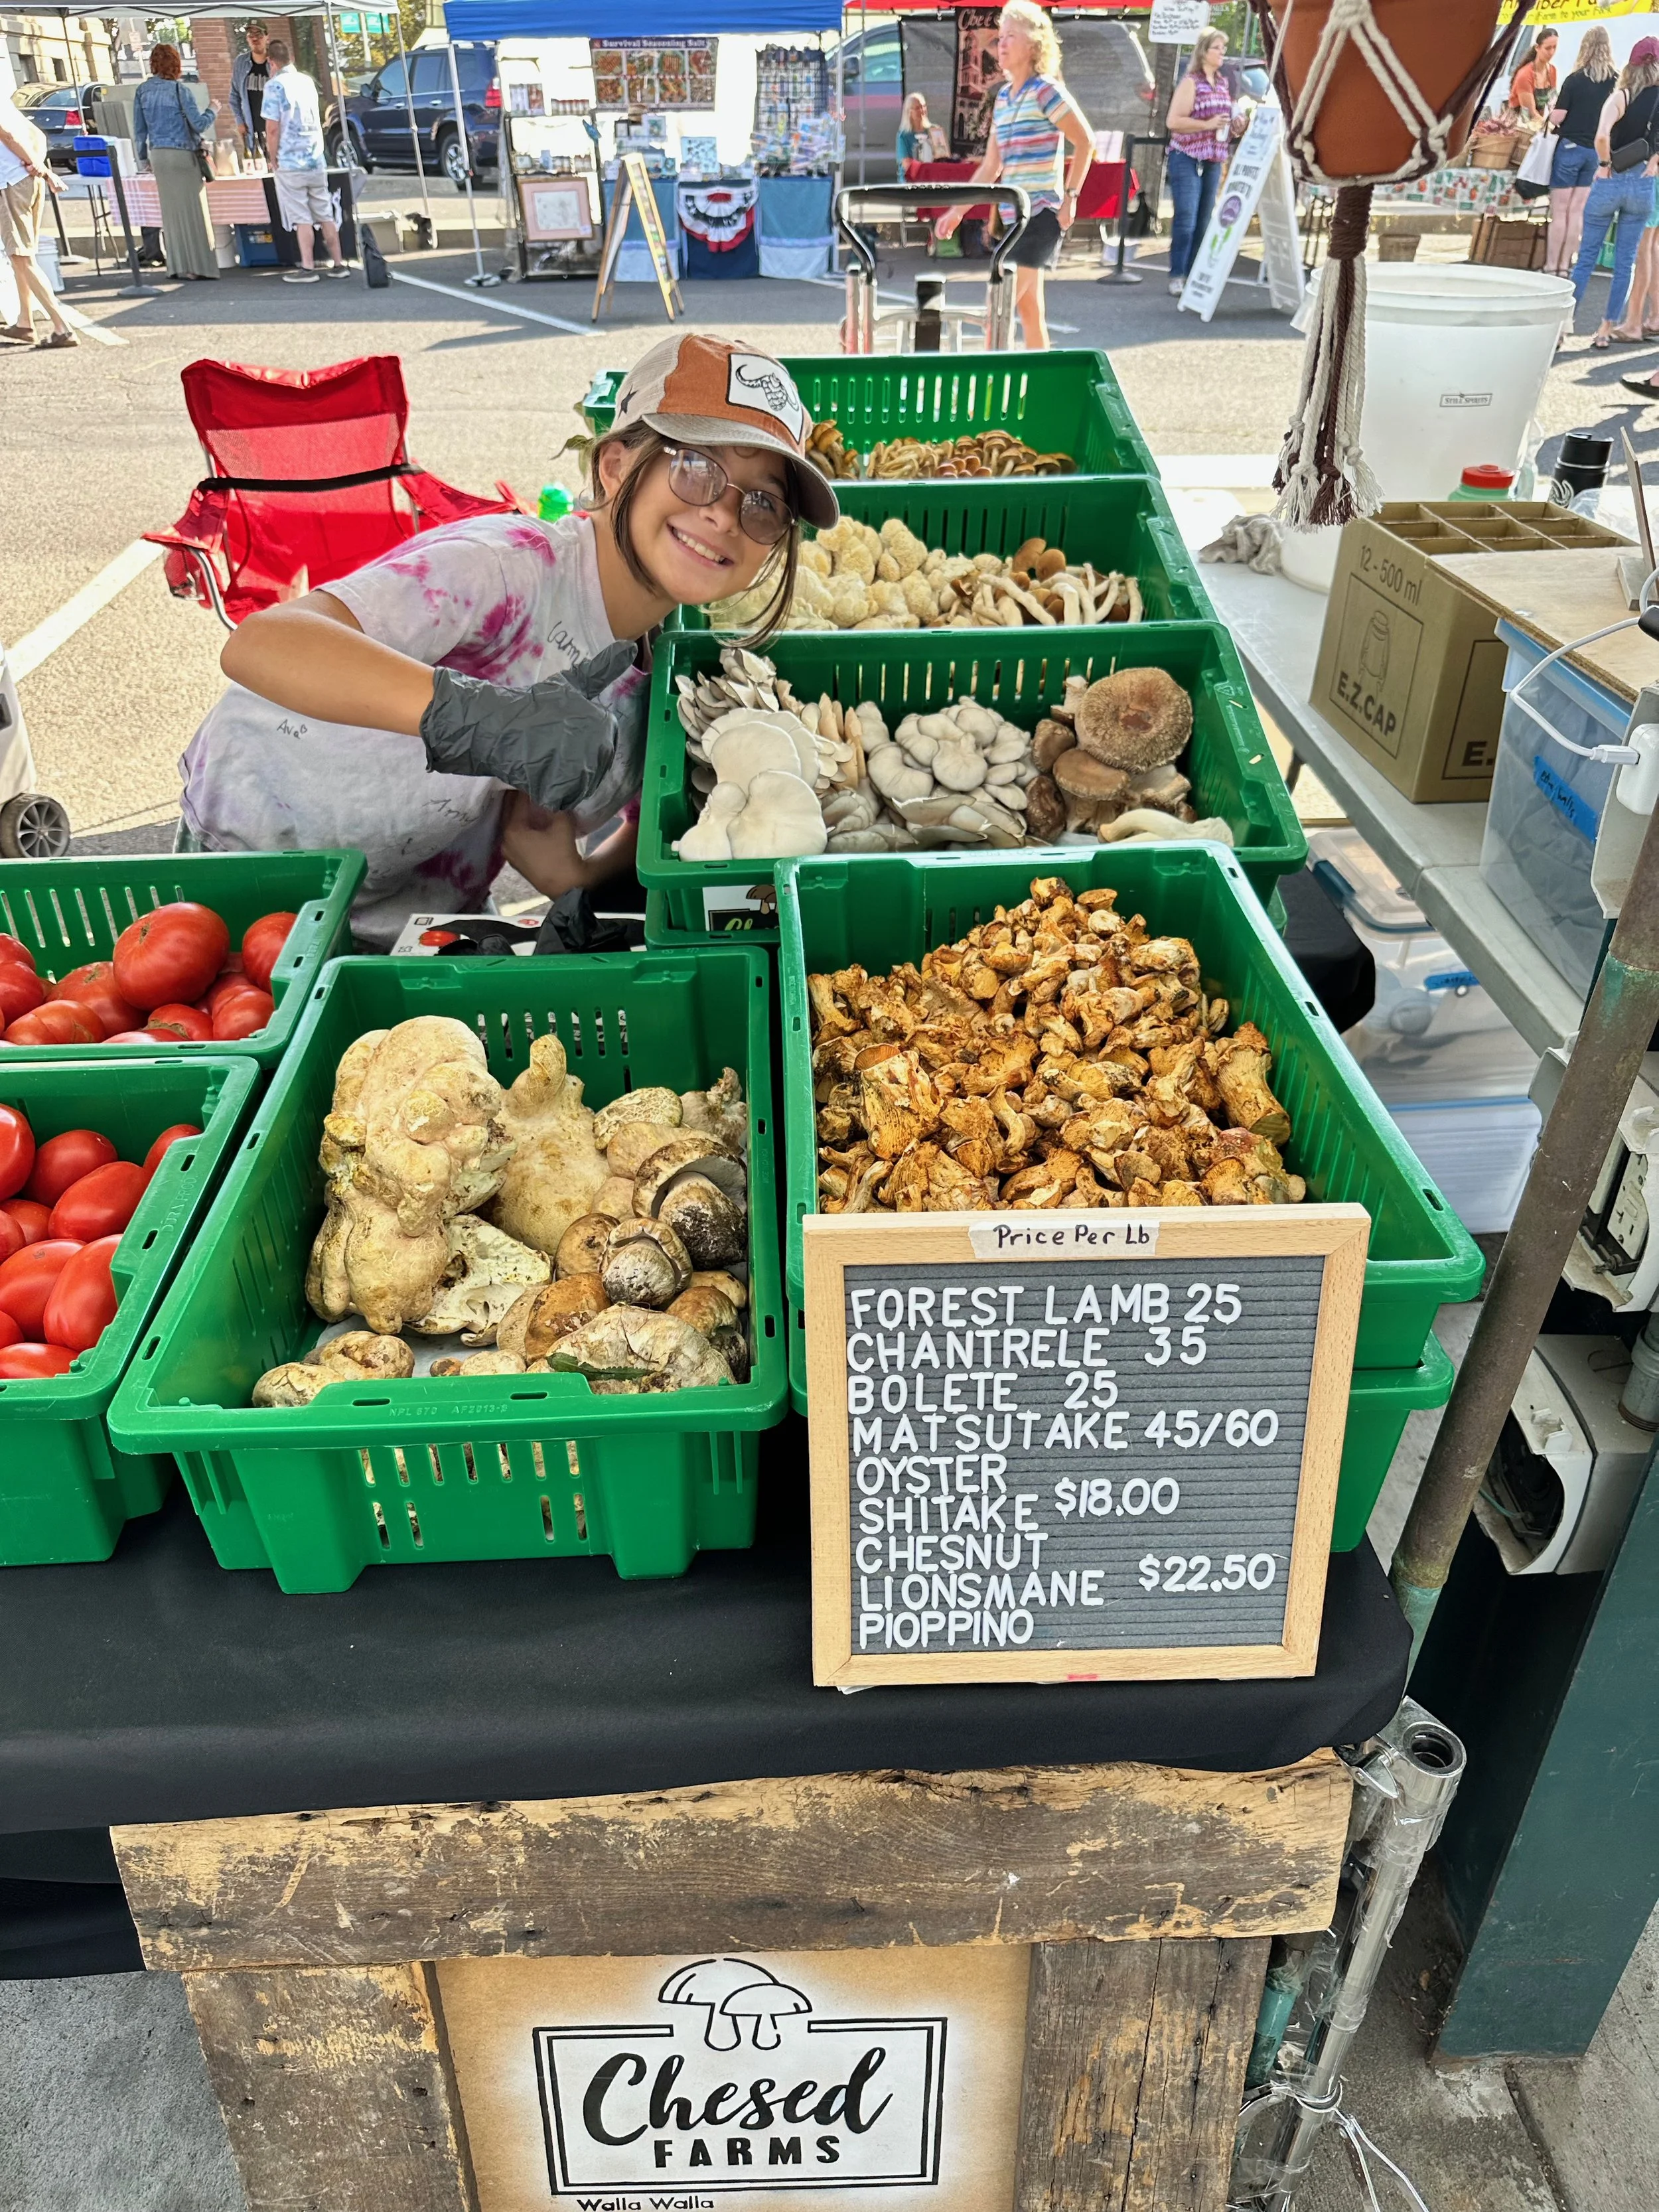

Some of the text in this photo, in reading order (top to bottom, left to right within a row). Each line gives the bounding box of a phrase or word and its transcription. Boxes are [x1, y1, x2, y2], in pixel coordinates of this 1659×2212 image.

[1360, 544, 1371, 573] 12
[1380, 558, 1404, 595] 500
[1404, 579, 1423, 607] ml
[1336, 670, 1398, 737] E.Z.CAP
[276, 718, 301, 740] Ava
[993, 1221, 1150, 1248] Price Per Lb
[851, 1283, 1242, 1331] FOREST LAMB 25
[847, 1326, 1207, 1374] CHANTRELE 35
[847, 1370, 1118, 1414] BOLETE 25
[853, 1408, 1279, 1456] MATSUTAKE 45/60
[856, 1453, 1007, 1497] OYSTER
[859, 1477, 1180, 1534] SHITAKE $18.00
[855, 1532, 1048, 1574] CHESNUT
[860, 1553, 1276, 1611] LIONSMANE $22.50
[859, 1609, 1034, 1650] PIOPPINO
[583, 2047, 894, 2146] Chesed
[654, 2136, 840, 2168] FARMS
[576, 2195, 715, 2212] Walla Walla
